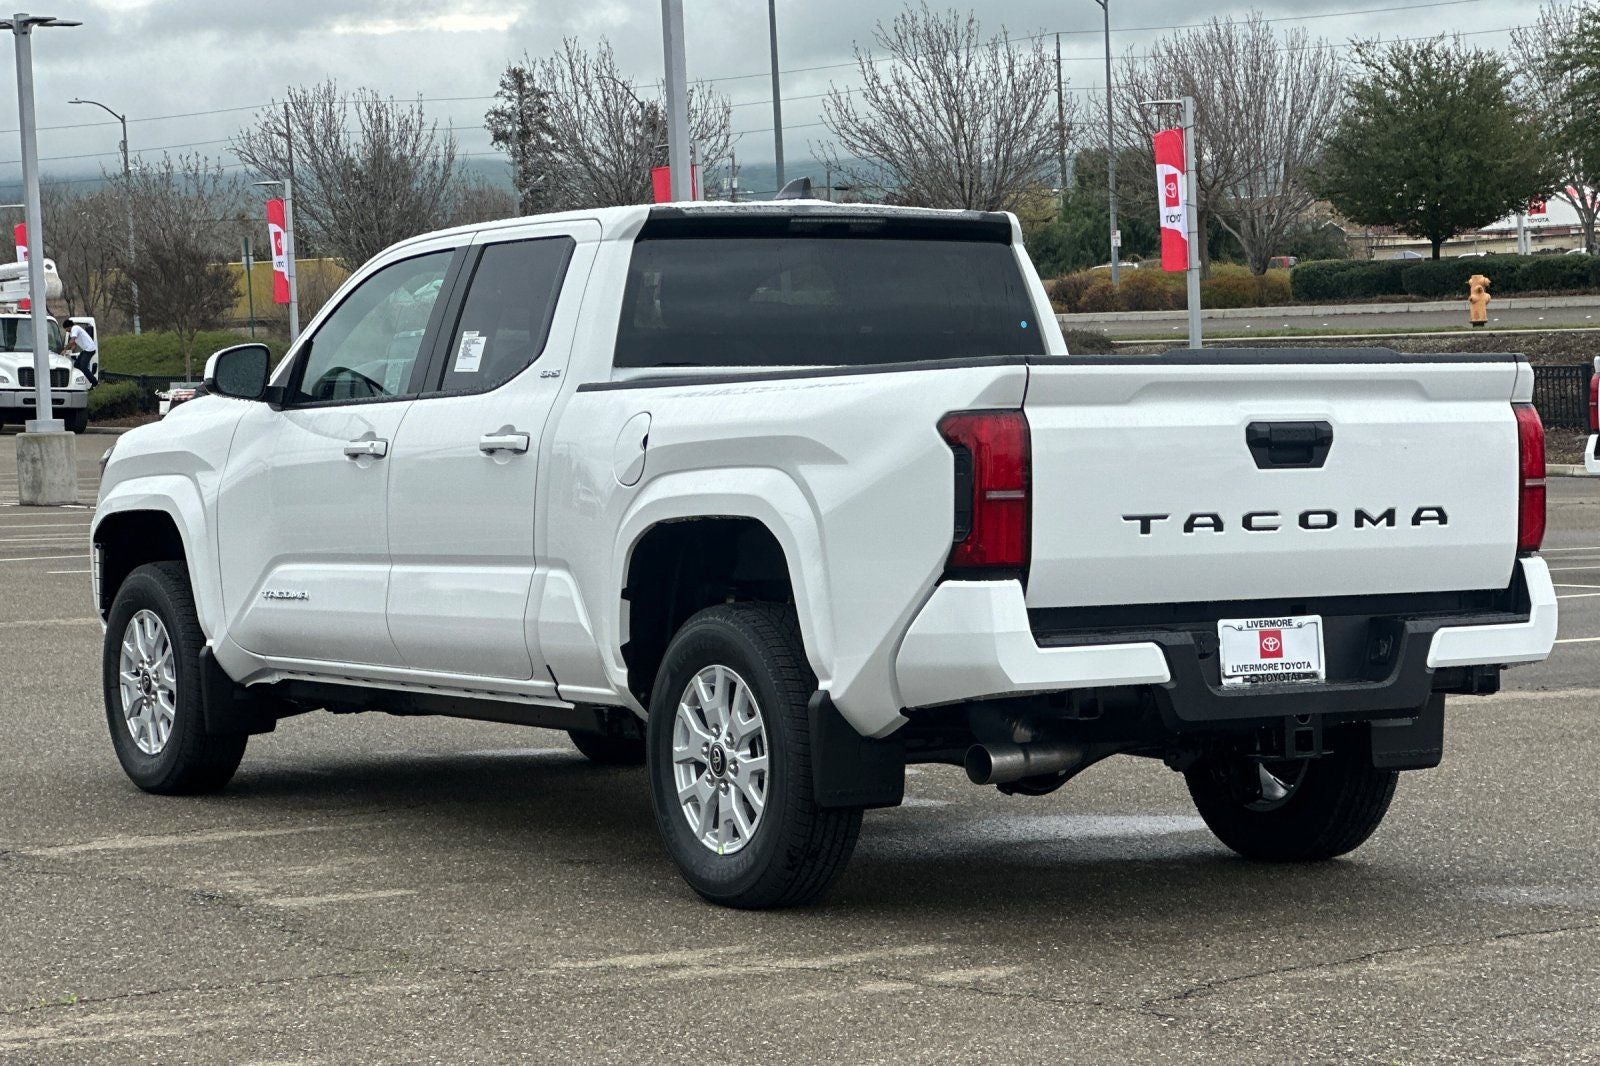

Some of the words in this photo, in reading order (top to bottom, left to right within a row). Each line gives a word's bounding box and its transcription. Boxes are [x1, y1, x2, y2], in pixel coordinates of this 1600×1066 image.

[1122, 506, 1448, 535] TACOMA
[261, 590, 309, 601] TACOMA
[1246, 618, 1293, 629] LIVERMORE
[1231, 662, 1279, 673] LIVERMORE
[1280, 661, 1312, 671] TOYOTA
[1260, 672, 1298, 682] TOYOTA
